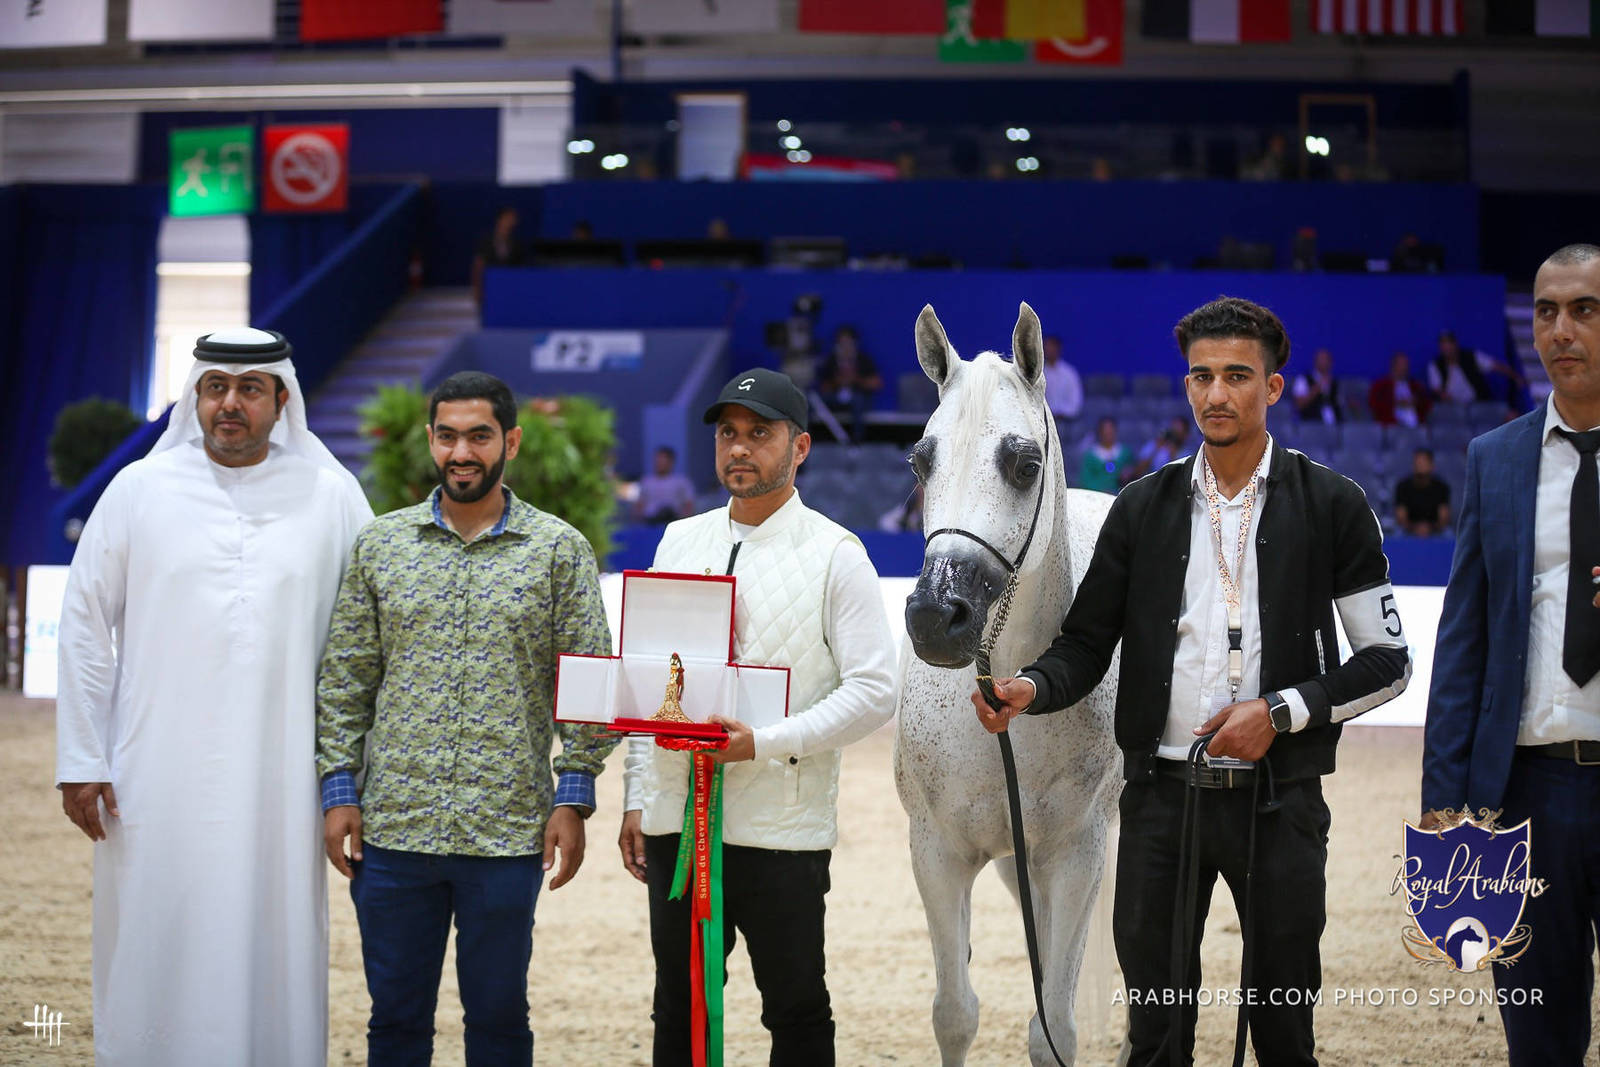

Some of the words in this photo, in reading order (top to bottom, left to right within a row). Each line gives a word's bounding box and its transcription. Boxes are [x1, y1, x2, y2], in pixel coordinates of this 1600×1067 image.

[1380, 593, 1402, 637] 5
[697, 816, 706, 851] Cheval
[698, 855, 706, 868] du
[699, 871, 707, 899] Salon
